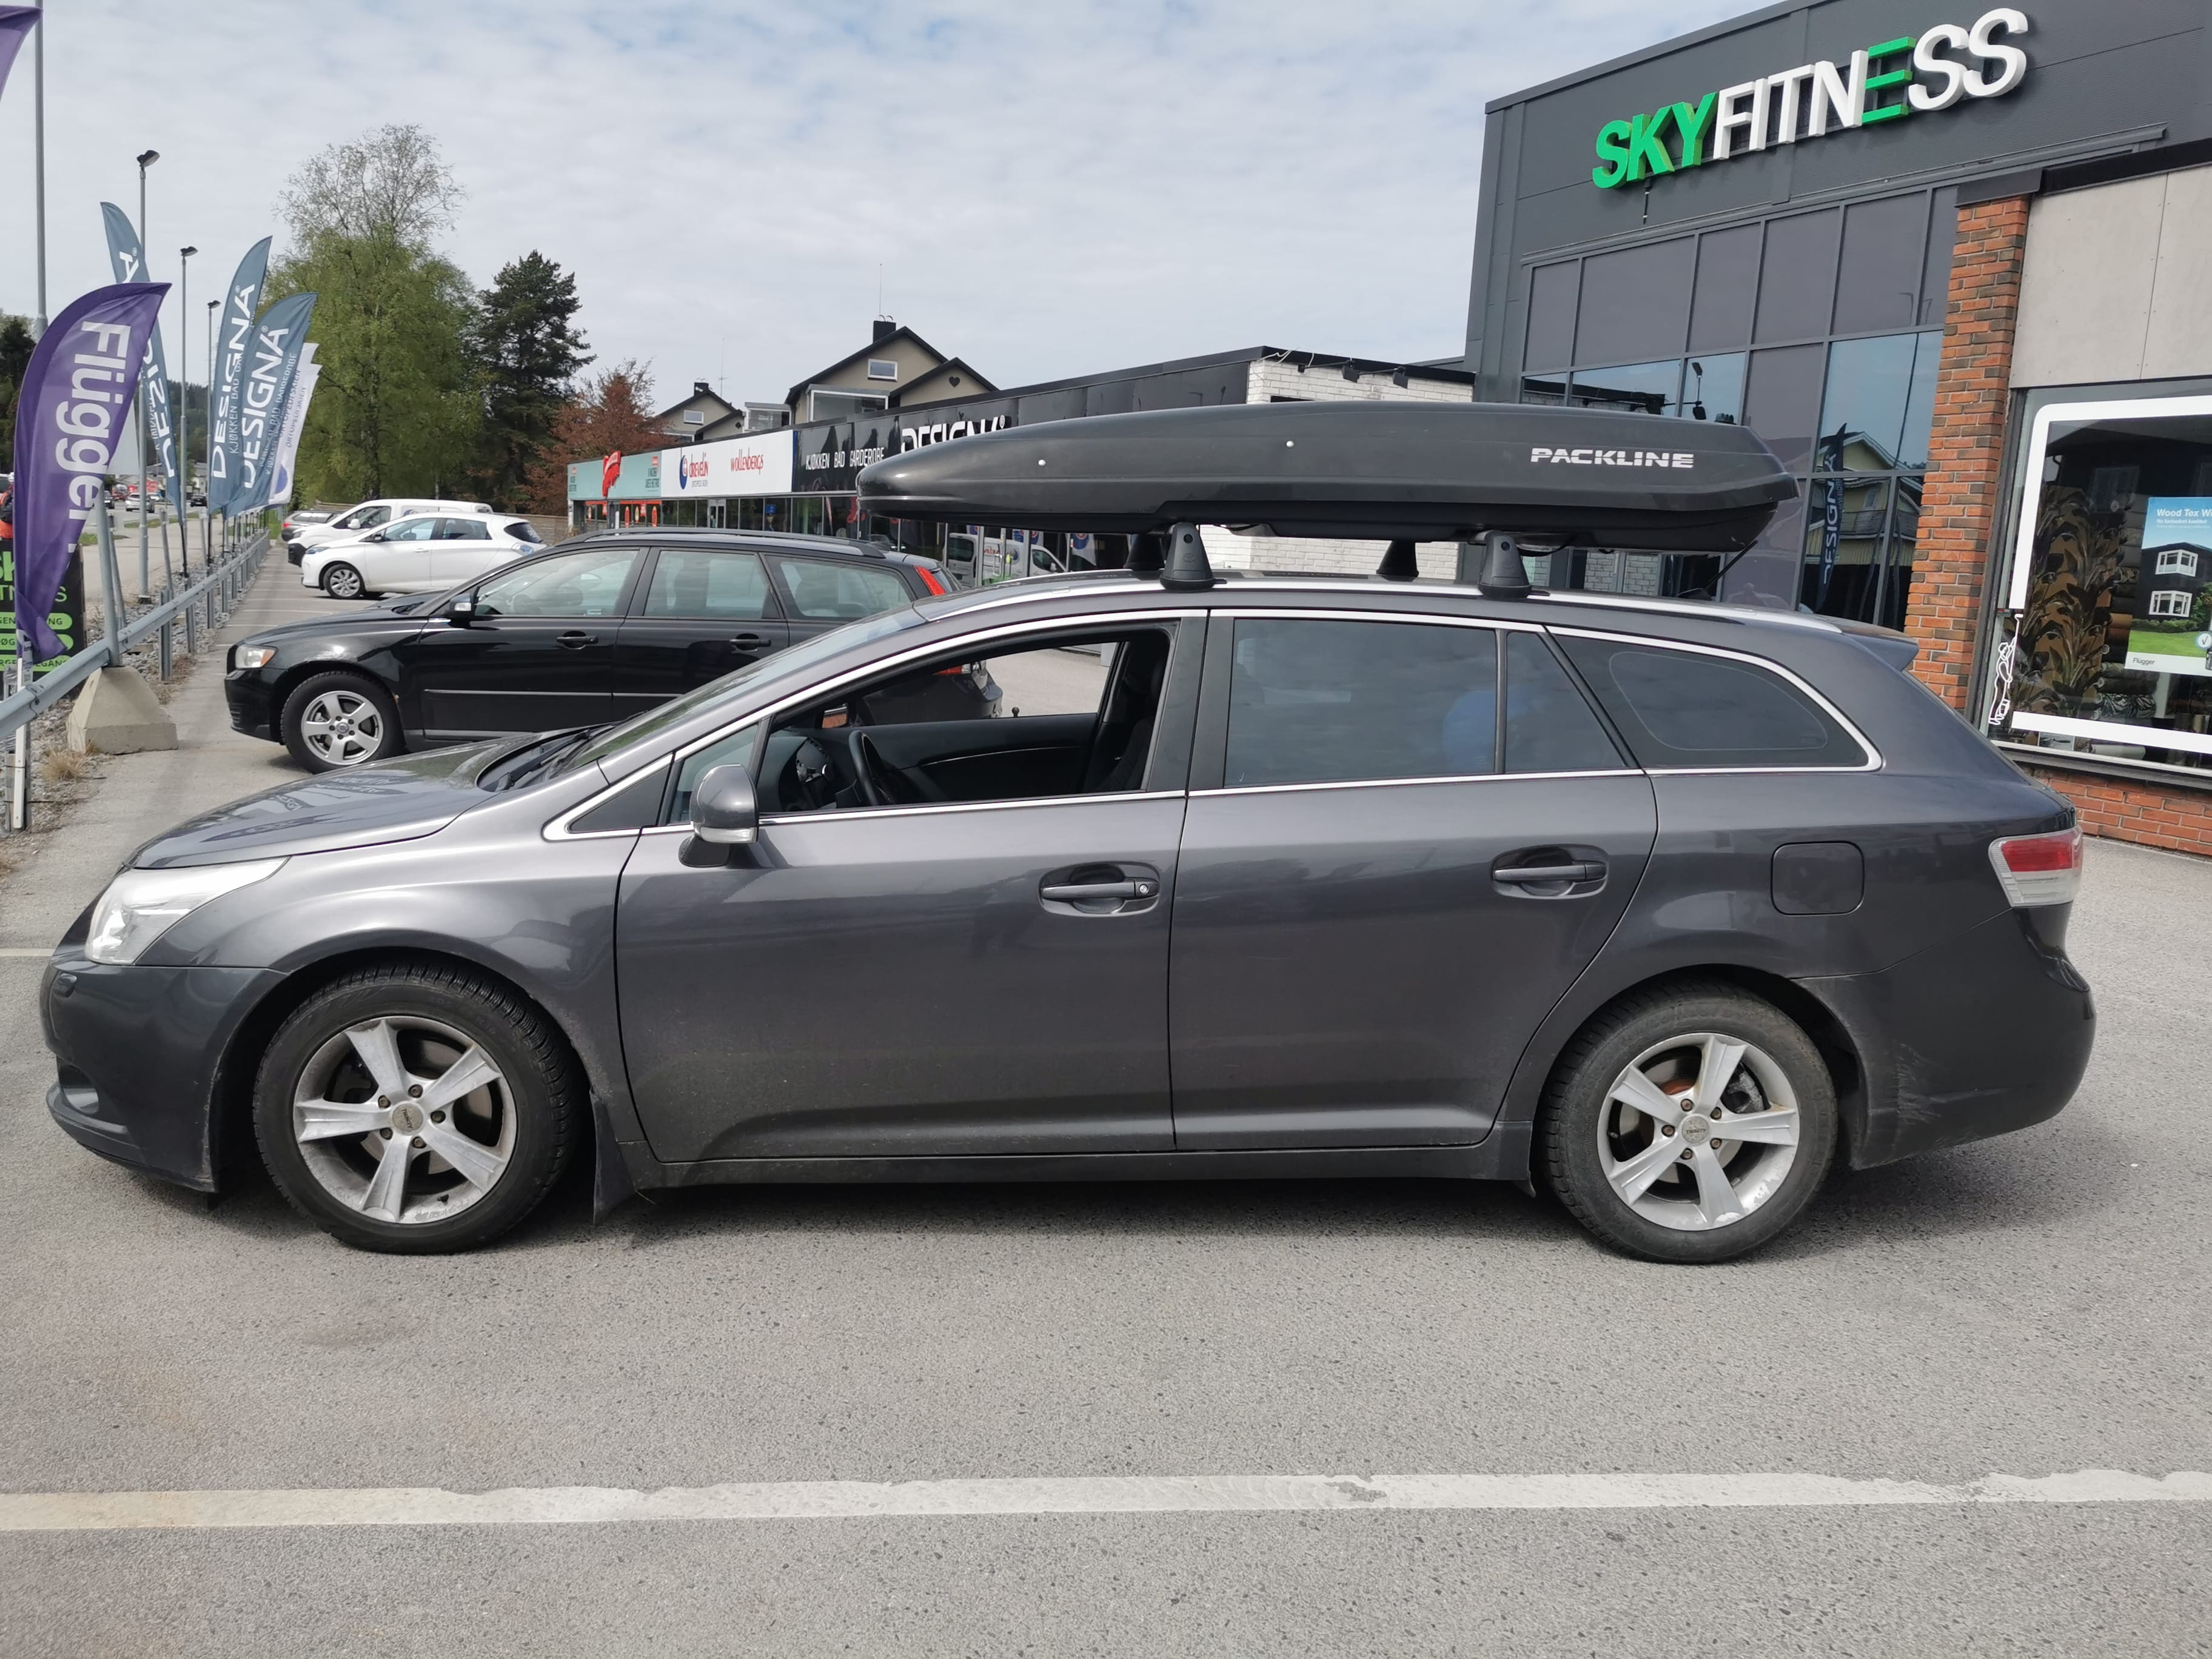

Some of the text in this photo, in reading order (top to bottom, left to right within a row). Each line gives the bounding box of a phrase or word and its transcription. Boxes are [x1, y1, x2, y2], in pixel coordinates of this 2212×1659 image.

[1592, 8, 2028, 189] SKYFITNESS
[213, 284, 255, 478] DESIGNA
[229, 406, 239, 454] KJØKKEN
[241, 328, 289, 489] DESIGNA
[805, 453, 830, 470] KJØKKEN
[834, 451, 845, 468] BAD
[1530, 447, 1694, 468] PACKLINE
